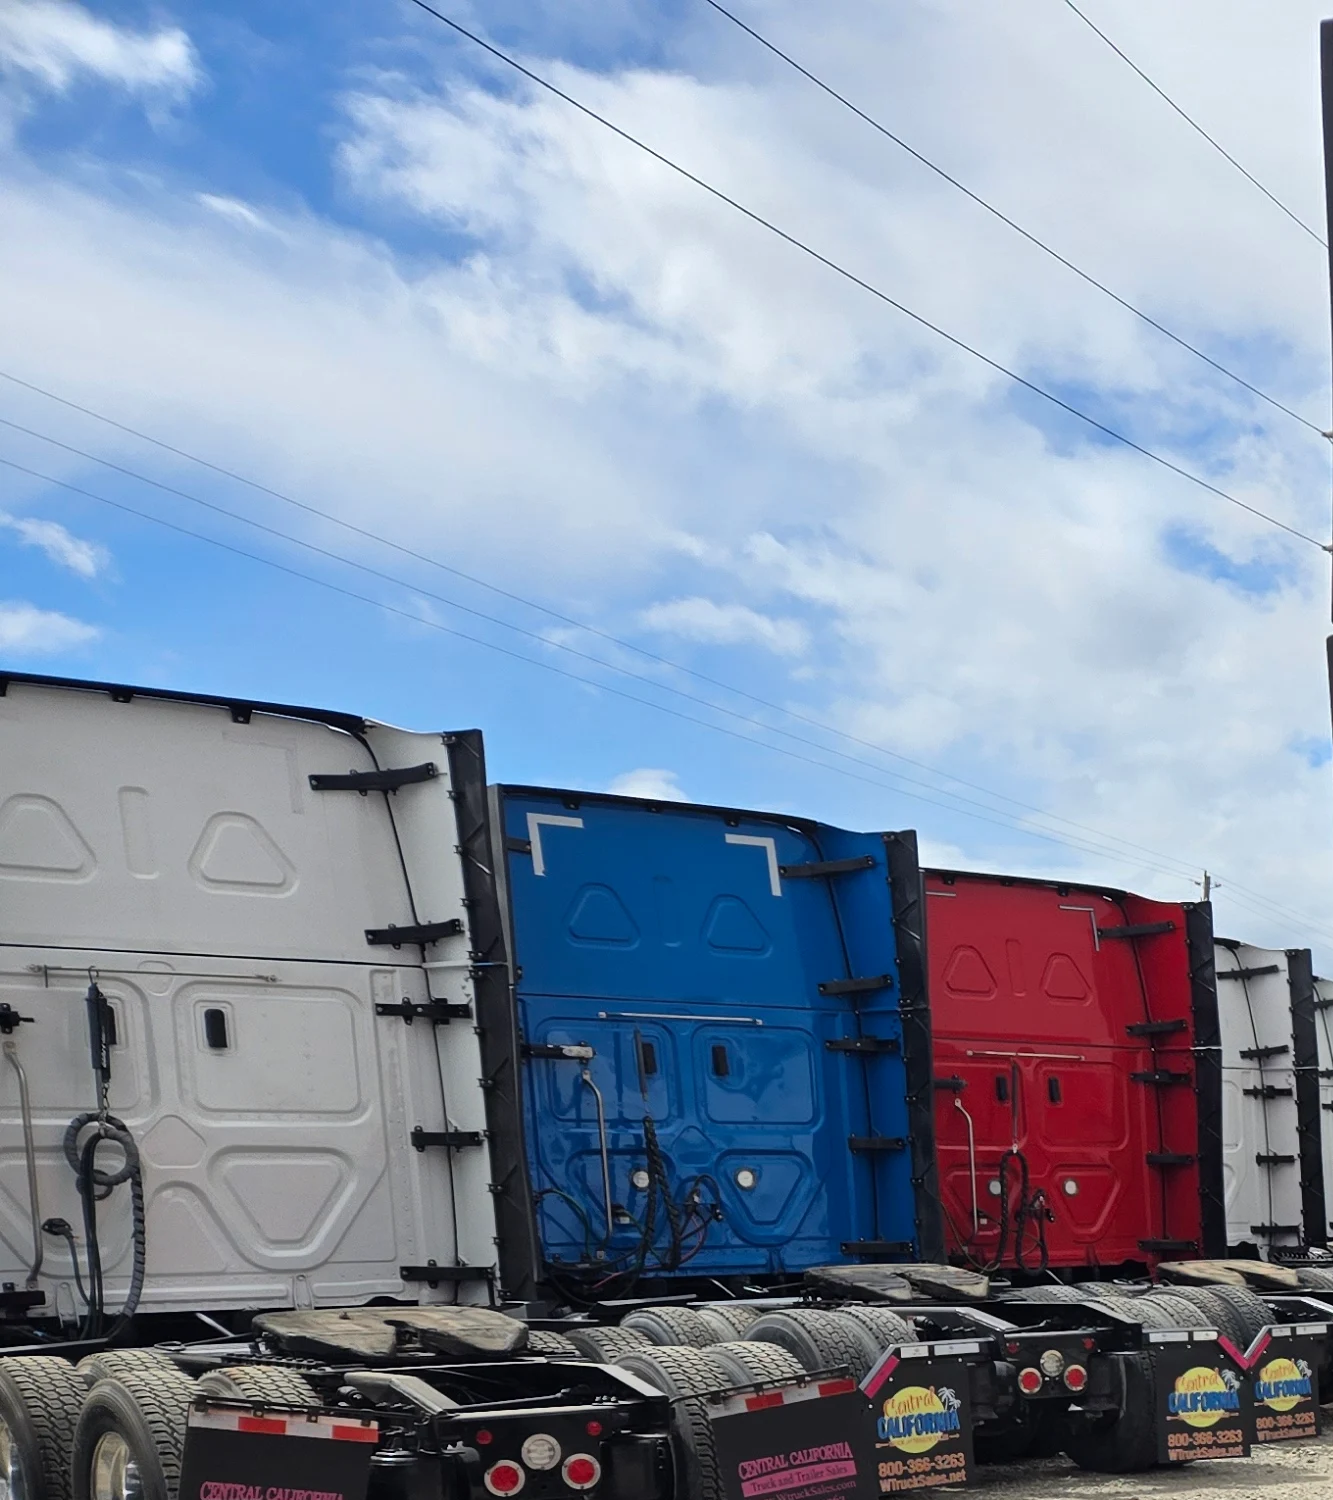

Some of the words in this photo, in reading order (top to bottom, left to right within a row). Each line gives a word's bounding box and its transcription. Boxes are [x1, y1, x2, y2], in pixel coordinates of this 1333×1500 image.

[883, 1385, 936, 1417] Central
[1168, 1390, 1240, 1413] CALIFORNIA
[876, 1409, 961, 1439] CALIFORNIA
[1167, 1429, 1243, 1447] 800-366-3263
[738, 1454, 789, 1480] CENTRAL
[789, 1441, 854, 1466] CALIFORNIA
[878, 1452, 966, 1478] 800-366-3263
[751, 1480, 776, 1492] Truck
[778, 1476, 793, 1487] and
[795, 1469, 824, 1485] Trailer
[826, 1465, 848, 1476] Sales
[879, 1468, 967, 1493] WTruckSales.net
